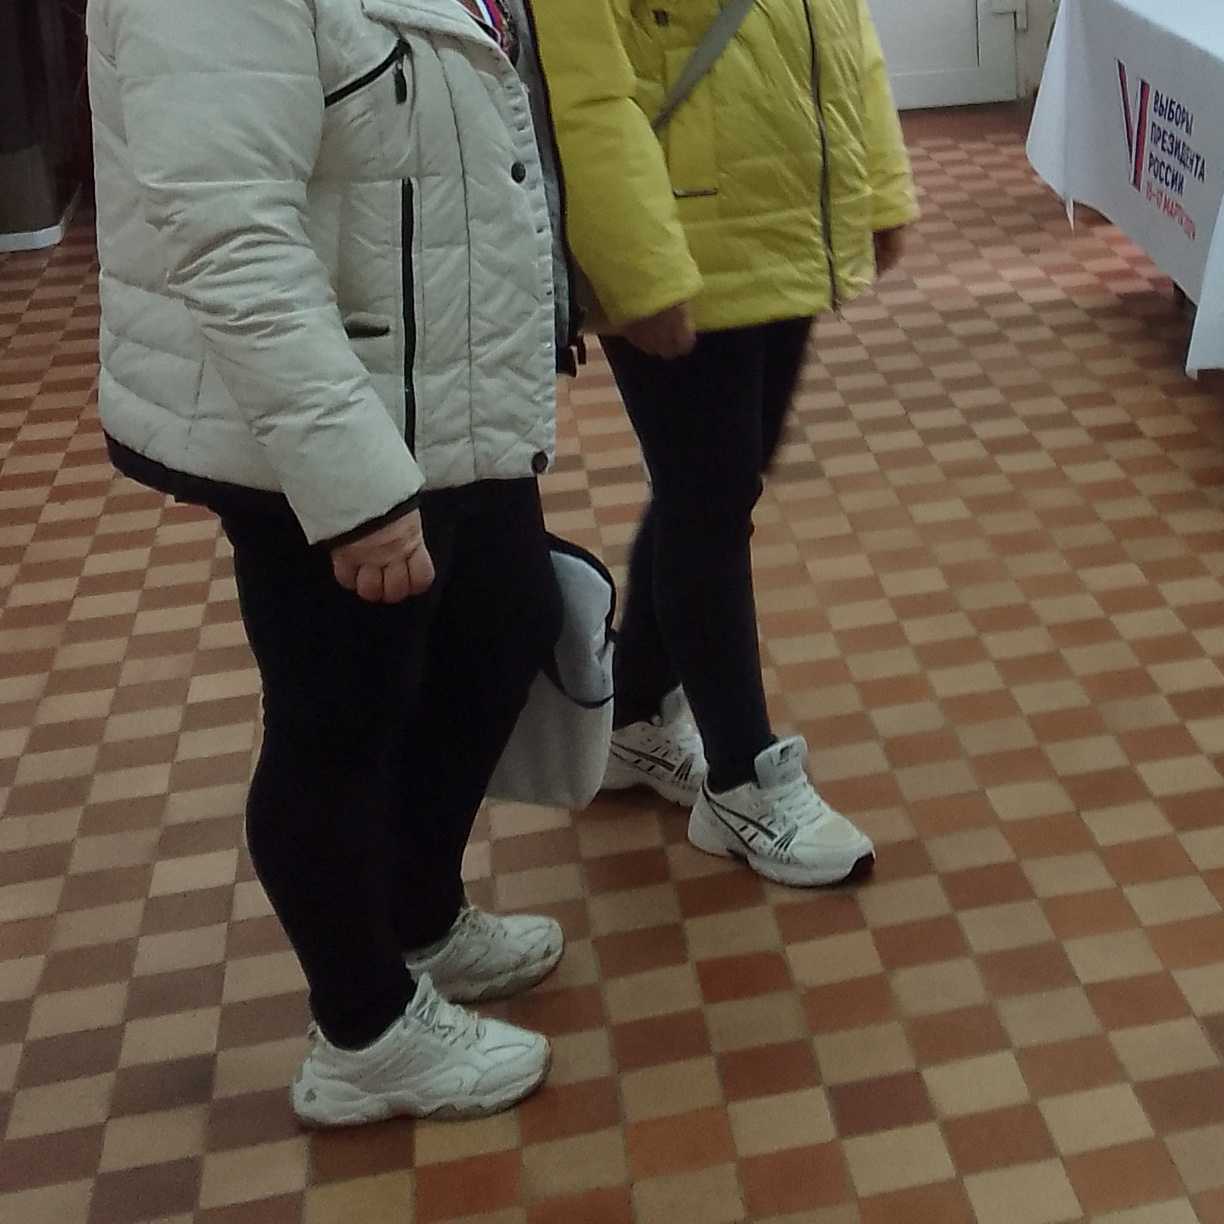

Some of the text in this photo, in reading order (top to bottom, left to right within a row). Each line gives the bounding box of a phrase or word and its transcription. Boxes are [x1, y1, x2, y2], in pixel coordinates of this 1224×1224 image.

[1153, 89, 1194, 138] ВЫБОРЫ
[1147, 152, 1185, 197] РОССИИ
[1150, 120, 1206, 184] ПРЕЗИДЕНТА
